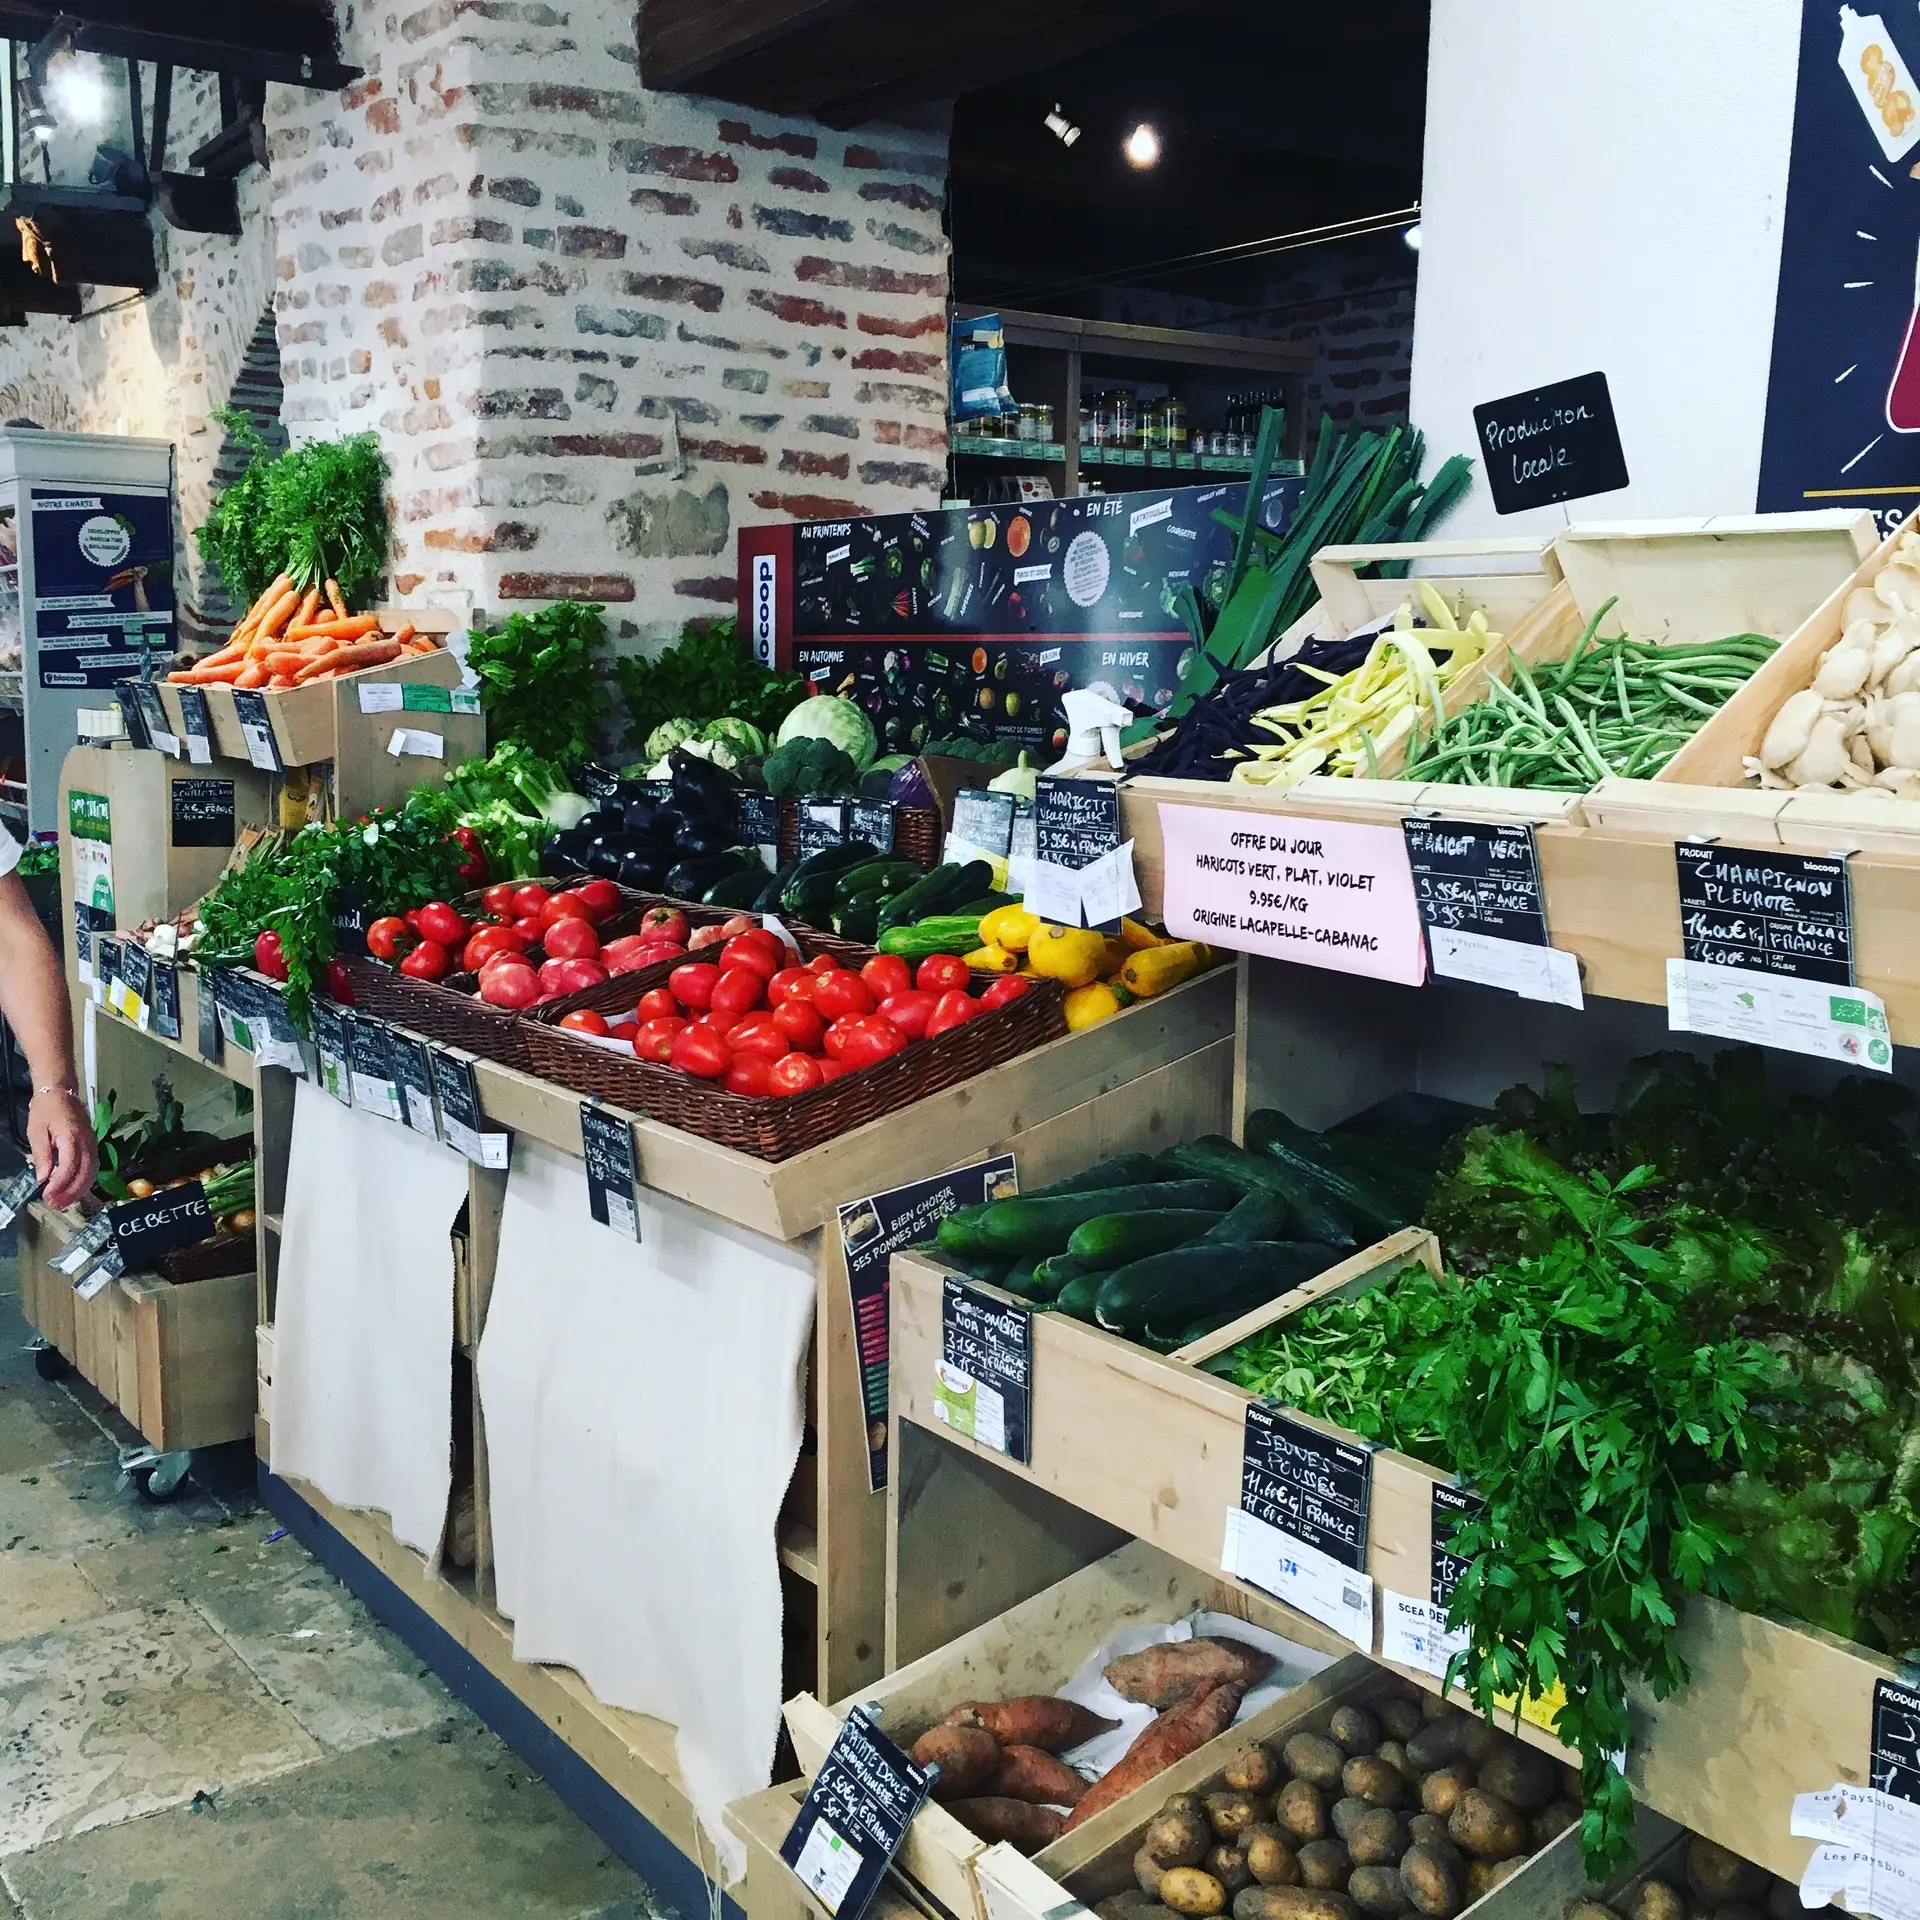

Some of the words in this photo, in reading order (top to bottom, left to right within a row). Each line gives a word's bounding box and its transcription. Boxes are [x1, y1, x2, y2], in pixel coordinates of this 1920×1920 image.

[1486, 405, 1595, 451] Production
[38, 501, 63, 509] NOTRE
[1086, 503, 1101, 517] EN
[1103, 498, 1123, 516] ÉTÉ
[801, 526, 811, 539] AU
[813, 523, 851, 538] PRINTEMPS
[799, 651, 809, 662] EN
[811, 650, 845, 663] AUTOMNE
[1102, 652, 1116, 666] EN
[1119, 652, 1149, 667] HIVER
[54, 674, 85, 684] biocoop
[1049, 791, 1107, 815] HARICOTS
[1497, 828, 1526, 837] biocoop
[1230, 832, 1266, 851] OFFRE
[1270, 836, 1286, 853] DU
[1290, 839, 1324, 858] JOUR
[1488, 840, 1531, 859] VERT
[1679, 847, 1714, 860] PRODUIT
[1196, 854, 1245, 876] HARICOTS
[1248, 862, 1280, 882] VERT,
[1285, 867, 1322, 886] PLAT,
[1327, 872, 1376, 892] VIOLET
[1803, 861, 1841, 875] biocoop
[1695, 862, 1833, 897] CHAMPIGNON
[1249, 890, 1309, 913] 9.95€/KG
[1704, 882, 1796, 911] PLEUROTE
[1193, 908, 1237, 928] ORIGINE
[1240, 916, 1379, 952] LACAPELLE-CABANAC
[1770, 933, 1834, 956] FRANCE
[1771, 961, 1797, 971] CALIBRE
[1772, 954, 1785, 962] CAT
[891, 1209, 914, 1232] BIEN
[917, 1185, 954, 1215] CHOISIR
[852, 1251, 872, 1272] SES
[873, 1229, 912, 1260] POMMES
[913, 1217, 927, 1233] DE
[987, 1355, 1024, 1382] FRANCE
[1248, 1410, 1273, 1426] PRODUIT
[1336, 1447, 1363, 1466] biocoop
[1435, 1489, 1467, 1508] PRODUIT
[1306, 1504, 1355, 1542] FRANCE
[1398, 1602, 1424, 1617] SCEA
[1824, 1853, 1847, 1861] Les
[1853, 1853, 1905, 1878] Paysbio
